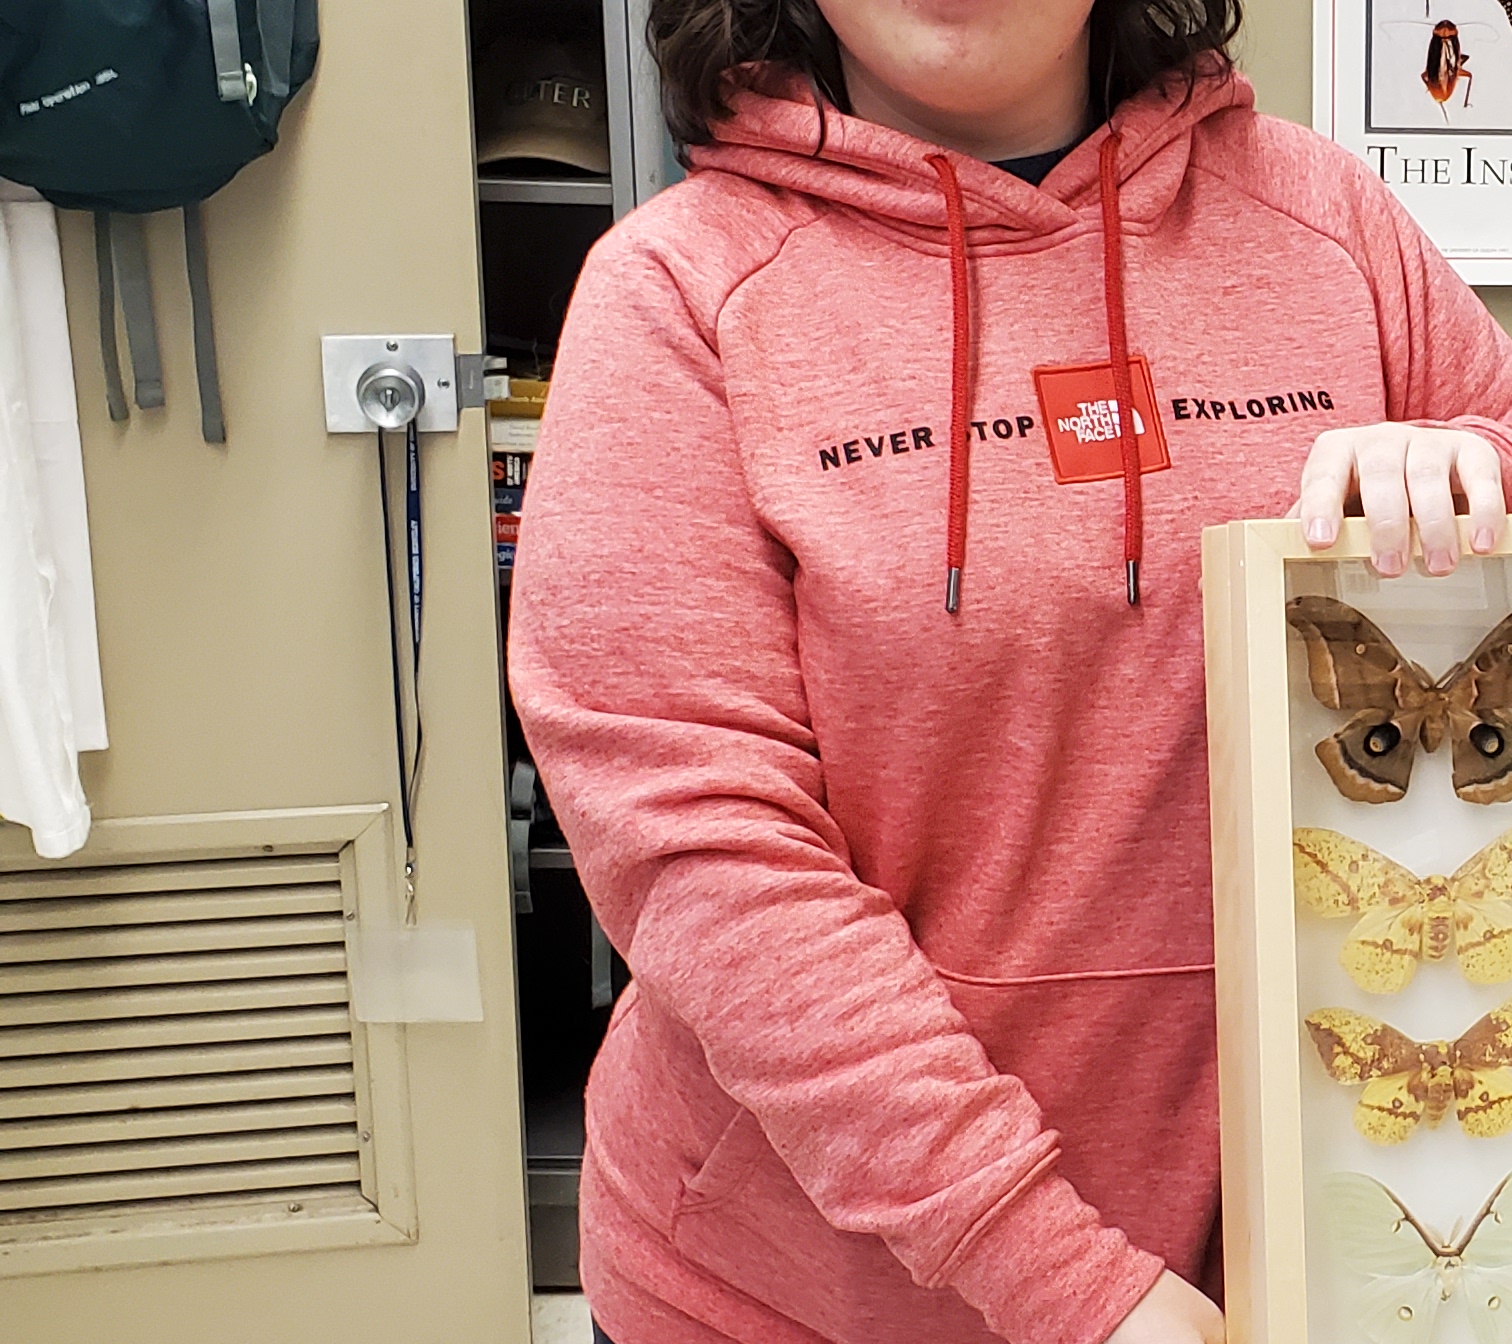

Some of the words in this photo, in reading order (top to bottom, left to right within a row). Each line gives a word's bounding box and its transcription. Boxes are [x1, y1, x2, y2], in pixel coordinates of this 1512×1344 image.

[1366, 146, 1451, 185] THE
[1077, 400, 1108, 416] THE
[818, 426, 935, 471] NEVER
[966, 416, 1035, 443] TOP
[1171, 390, 1335, 421] EXPLORING
[1057, 412, 1113, 432] NORTH
[1075, 427, 1115, 444] FACE
